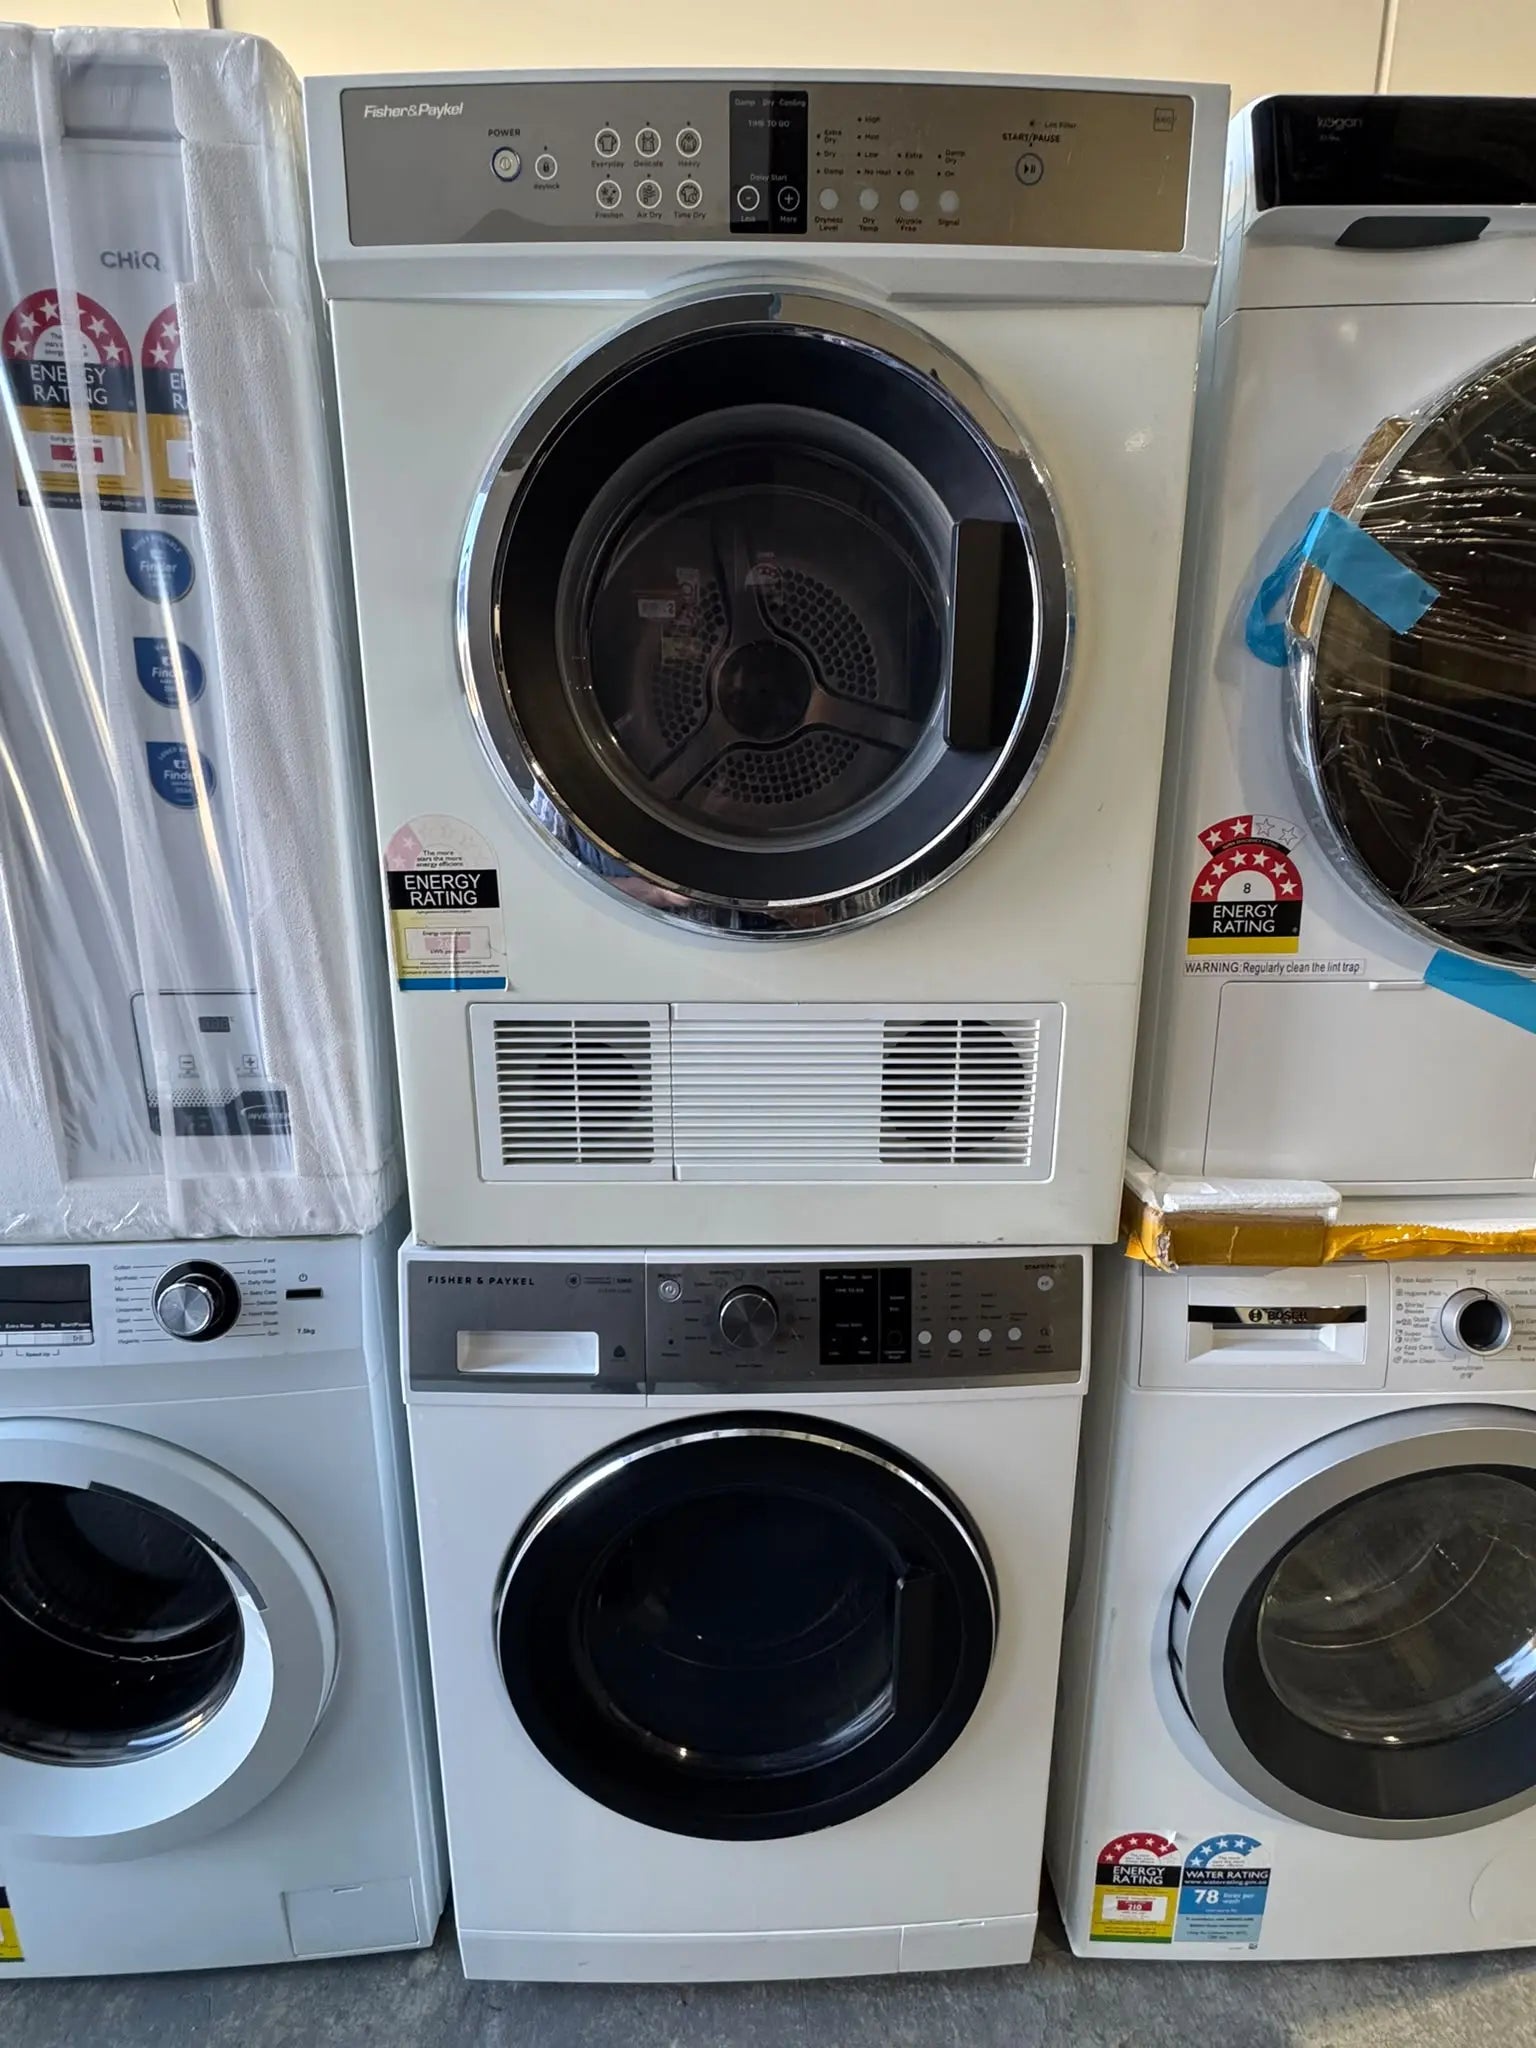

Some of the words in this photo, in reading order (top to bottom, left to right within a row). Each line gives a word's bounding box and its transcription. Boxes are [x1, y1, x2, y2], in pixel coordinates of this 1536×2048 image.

[364, 101, 464, 120] Fisher&Paykel
[767, 120, 777, 128] TO
[488, 128, 520, 137] POWER
[1002, 132, 1061, 144] START/PAUSE
[590, 161, 625, 169] Everyday
[633, 160, 664, 168] Delicate
[678, 161, 701, 169] Heavy
[823, 168, 844, 176] Damp
[649, 212, 664, 220] Dry
[693, 212, 707, 220] Dry
[862, 216, 876, 224] Dry
[100, 251, 161, 271] CHiQ
[30, 364, 107, 385] ENEGY
[33, 384, 108, 405] RATNG
[404, 874, 481, 890] ENERGY
[1243, 882, 1252, 894] 8
[410, 890, 478, 906] RATING
[1212, 904, 1279, 919] ENERGY
[1212, 919, 1276, 933] RATING
[1242, 962, 1284, 977] Regularly
[1286, 962, 1310, 974] clean
[1311, 961, 1325, 974] the
[1327, 961, 1341, 974] lint
[1342, 962, 1360, 976] trap
[427, 1276, 472, 1286] FISHER
[488, 1276, 536, 1287] PAYKEL
[1267, 1310, 1308, 1322] BOSCH
[1112, 1865, 1166, 1877] ENERGY
[1185, 1870, 1225, 1880] WATER
[1226, 1870, 1269, 1880] RATING
[1112, 1874, 1164, 1886] RATING
[1194, 1888, 1220, 1905] 78
[1127, 1903, 1143, 1912] 210
